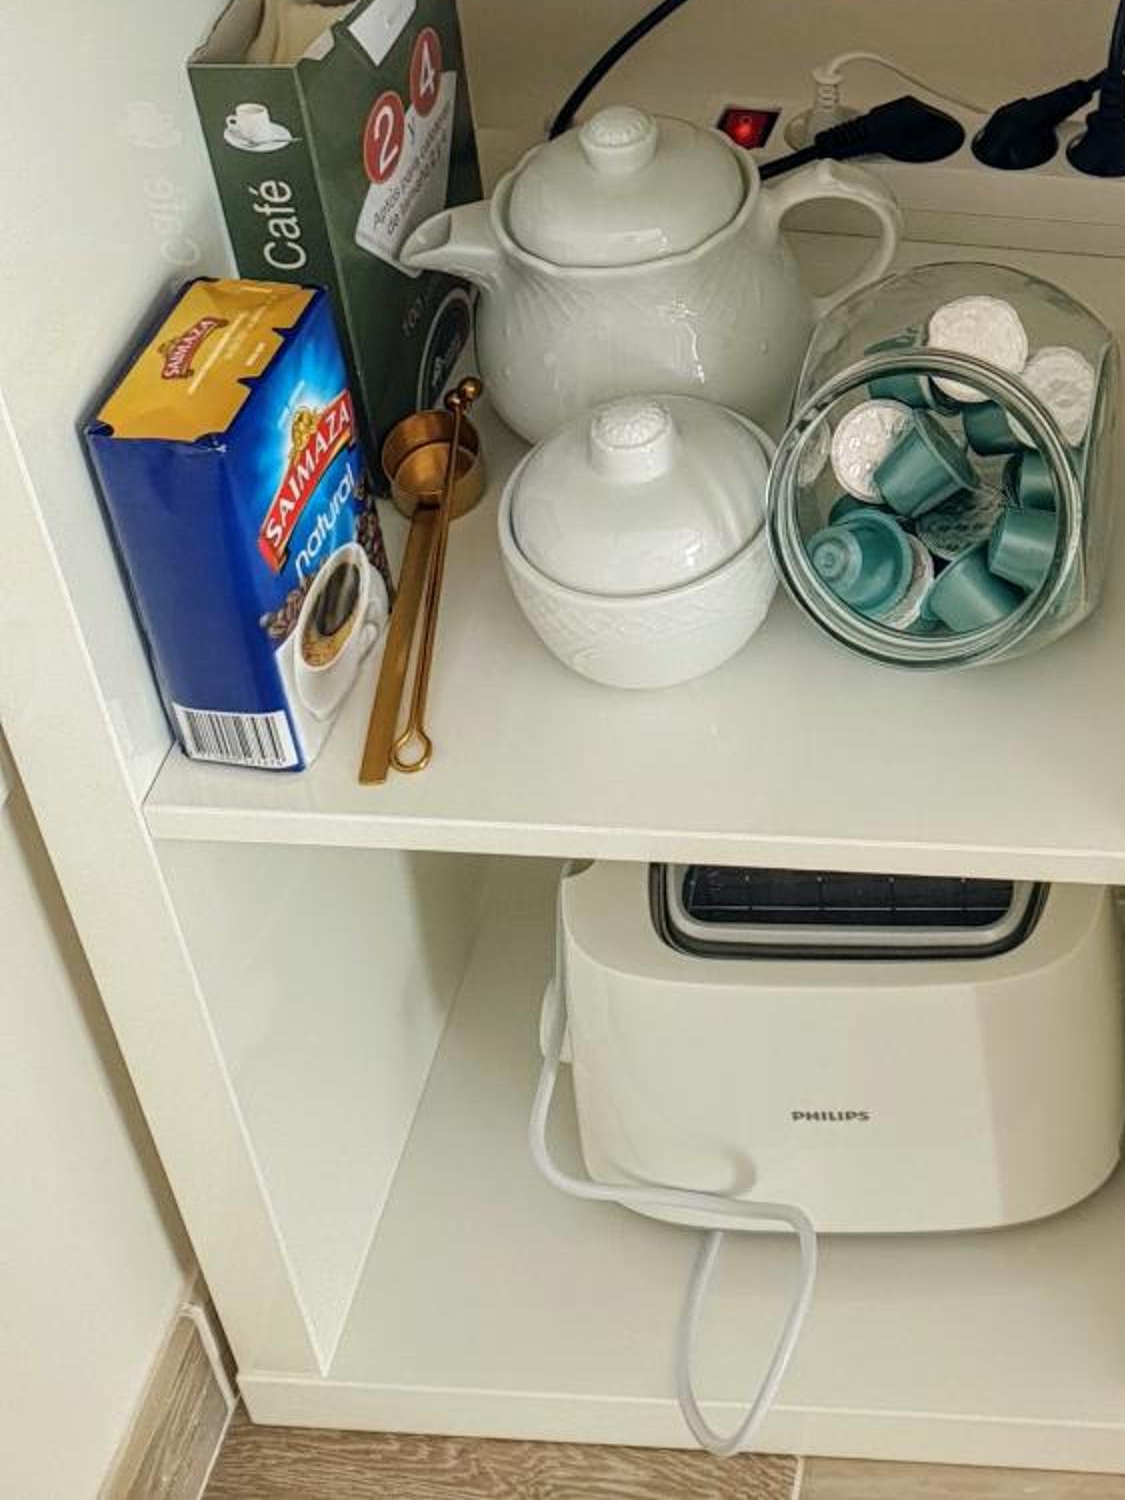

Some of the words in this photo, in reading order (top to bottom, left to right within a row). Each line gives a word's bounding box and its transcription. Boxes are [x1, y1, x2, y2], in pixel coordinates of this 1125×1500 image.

[373, 105, 399, 175] 2
[419, 41, 436, 99] 4
[247, 178, 308, 271] Café
[266, 400, 350, 547] SAIMAZA
[295, 461, 355, 588] natural
[791, 1111, 870, 1122] PHILIPS
